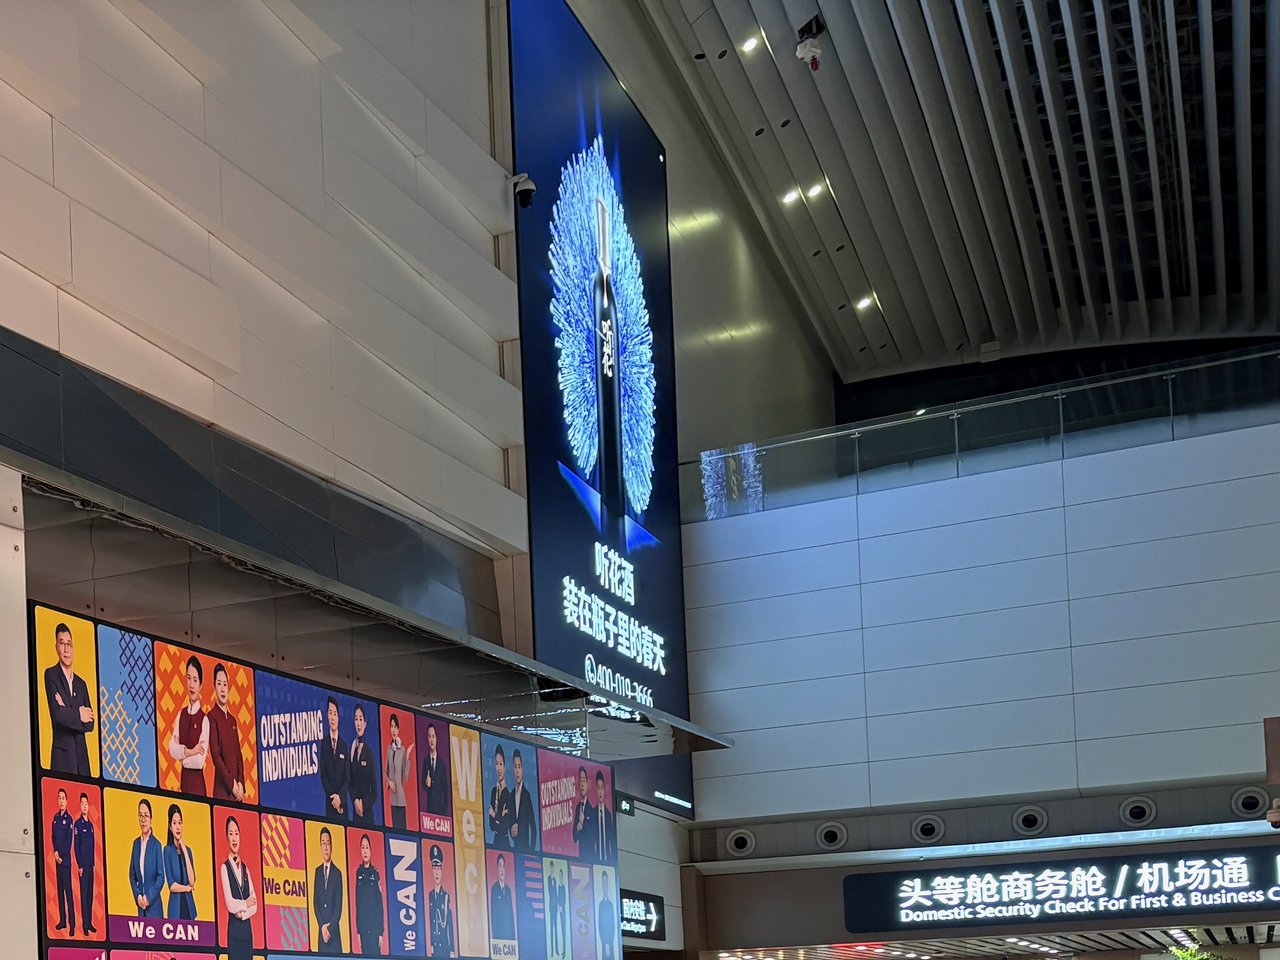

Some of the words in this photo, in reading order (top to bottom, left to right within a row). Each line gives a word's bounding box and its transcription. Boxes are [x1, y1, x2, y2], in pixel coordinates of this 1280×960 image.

[594, 541, 635, 606] 听花酒
[562, 575, 666, 676] 装在瓶子里的春天
[260, 709, 324, 748] OUTSTANDING
[262, 743, 319, 783] INDIVIDUALS
[423, 815, 435, 830] We
[435, 817, 451, 833] CAN
[263, 877, 281, 897] We
[283, 879, 306, 898] CAN
[388, 838, 418, 926] CAN
[1136, 856, 1251, 894] 机场通
[900, 905, 974, 922] Domestic
[975, 902, 1041, 919] Security
[1044, 897, 1096, 914] Check
[1099, 897, 1127, 912] For
[1131, 894, 1169, 908] First
[1172, 892, 1187, 907] &
[1190, 889, 1265, 906] Business
[128, 921, 156, 939] We
[162, 923, 199, 941] CAN
[403, 930, 416, 951] We
[492, 943, 503, 956] We
[502, 944, 516, 956] CAN
